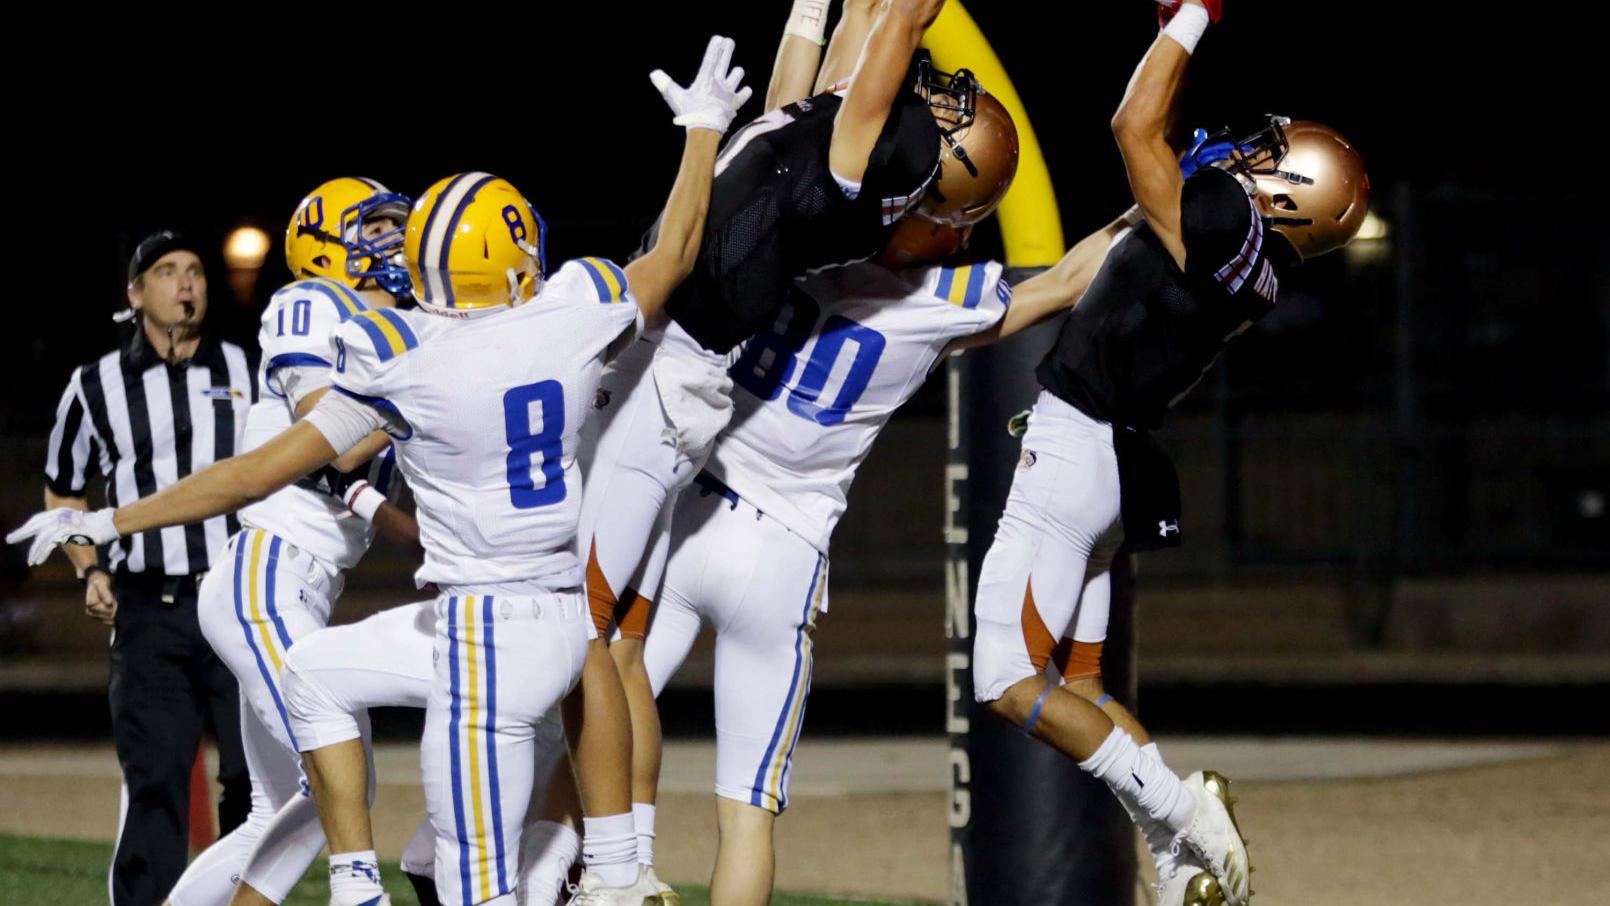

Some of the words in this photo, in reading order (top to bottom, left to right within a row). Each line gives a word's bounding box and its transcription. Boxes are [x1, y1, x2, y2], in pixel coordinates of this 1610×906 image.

[501, 204, 527, 245] 8
[277, 300, 312, 337] 10
[334, 335, 346, 374] 8
[727, 285, 887, 427] 80
[503, 379, 567, 510] 8
[944, 349, 971, 906] IENEGA
